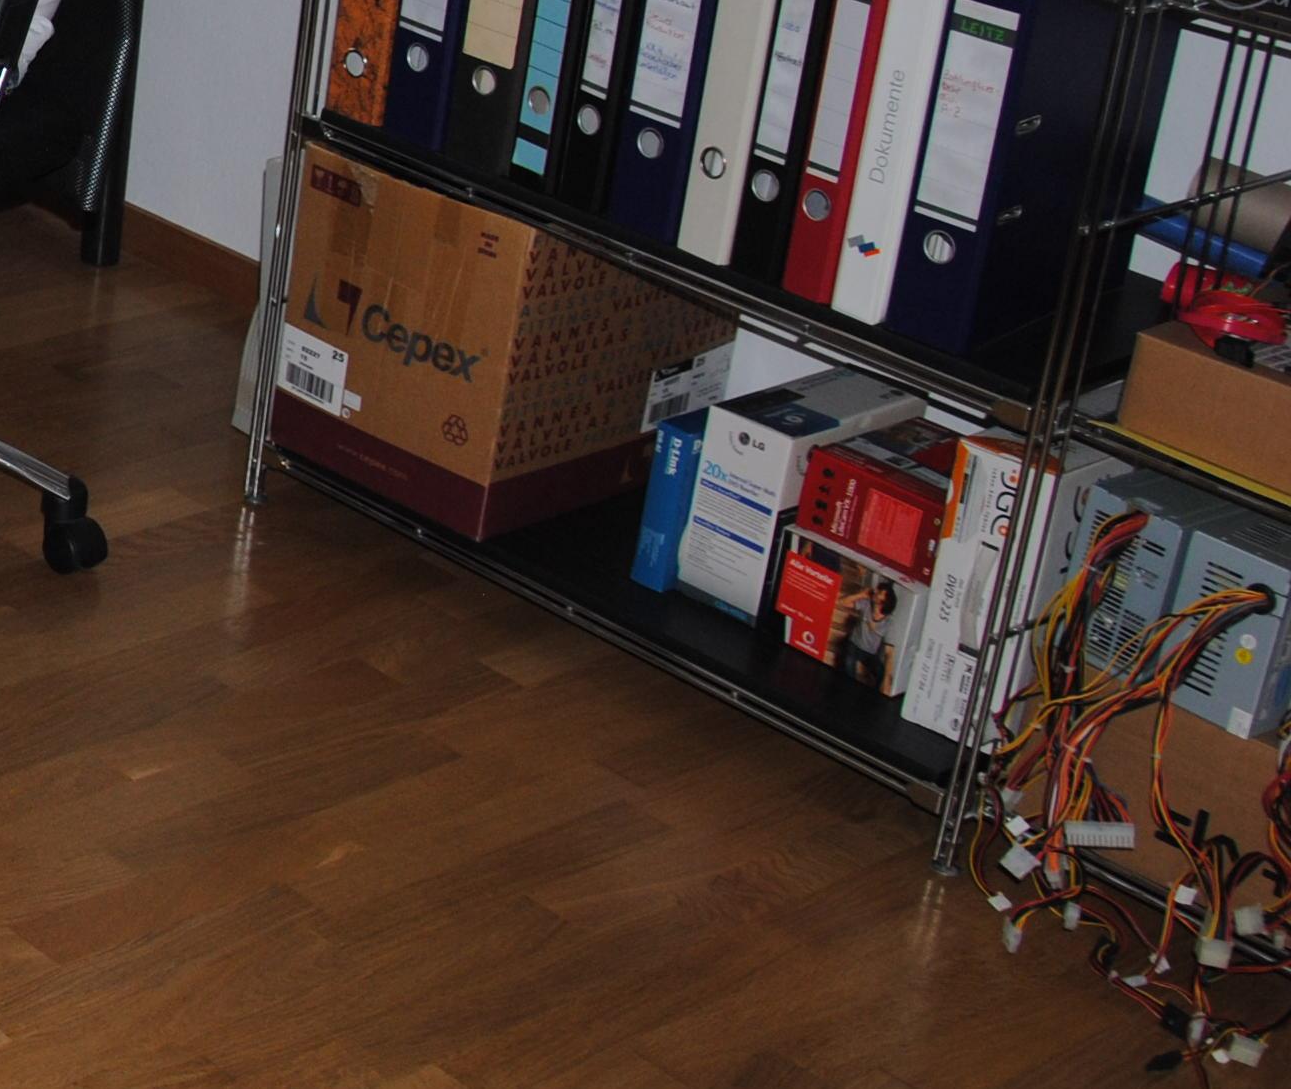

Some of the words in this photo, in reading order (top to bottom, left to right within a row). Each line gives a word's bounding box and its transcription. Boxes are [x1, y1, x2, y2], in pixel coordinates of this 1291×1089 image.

[960, 19, 1005, 42] LEITZ
[868, 69, 906, 185] Dokumente
[523, 271, 607, 299] VALVOLE
[362, 303, 480, 384] Cepex
[514, 318, 609, 351] VANNES
[332, 350, 345, 363] 25
[508, 355, 589, 383] VALVOLE
[500, 402, 591, 437] VANNES
[494, 438, 572, 470] VALVOLE
[752, 439, 765, 451] LG
[939, 573, 958, 623] DVD-225
